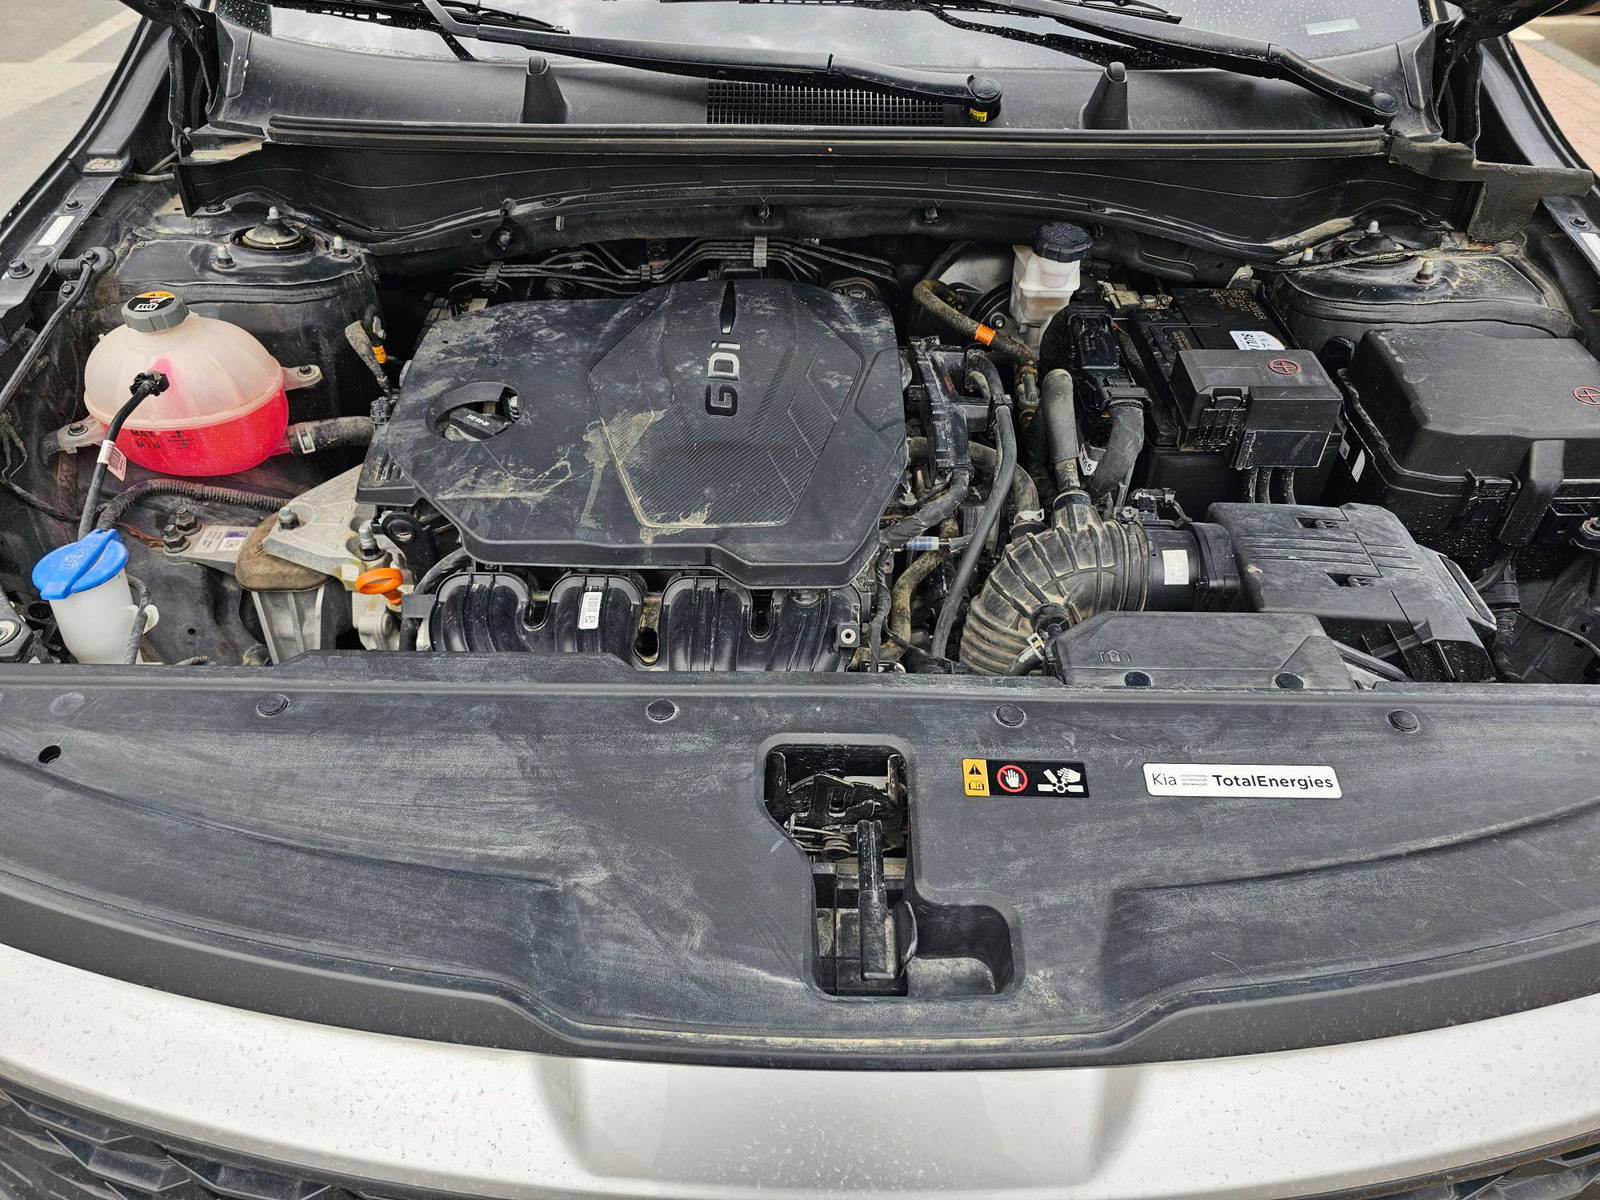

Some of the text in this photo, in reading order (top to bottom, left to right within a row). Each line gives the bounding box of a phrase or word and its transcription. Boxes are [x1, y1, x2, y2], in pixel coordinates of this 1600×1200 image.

[705, 341, 741, 416] GDi
[1151, 773, 1177, 786] Kia
[1212, 774, 1334, 790] TotalEnergies
